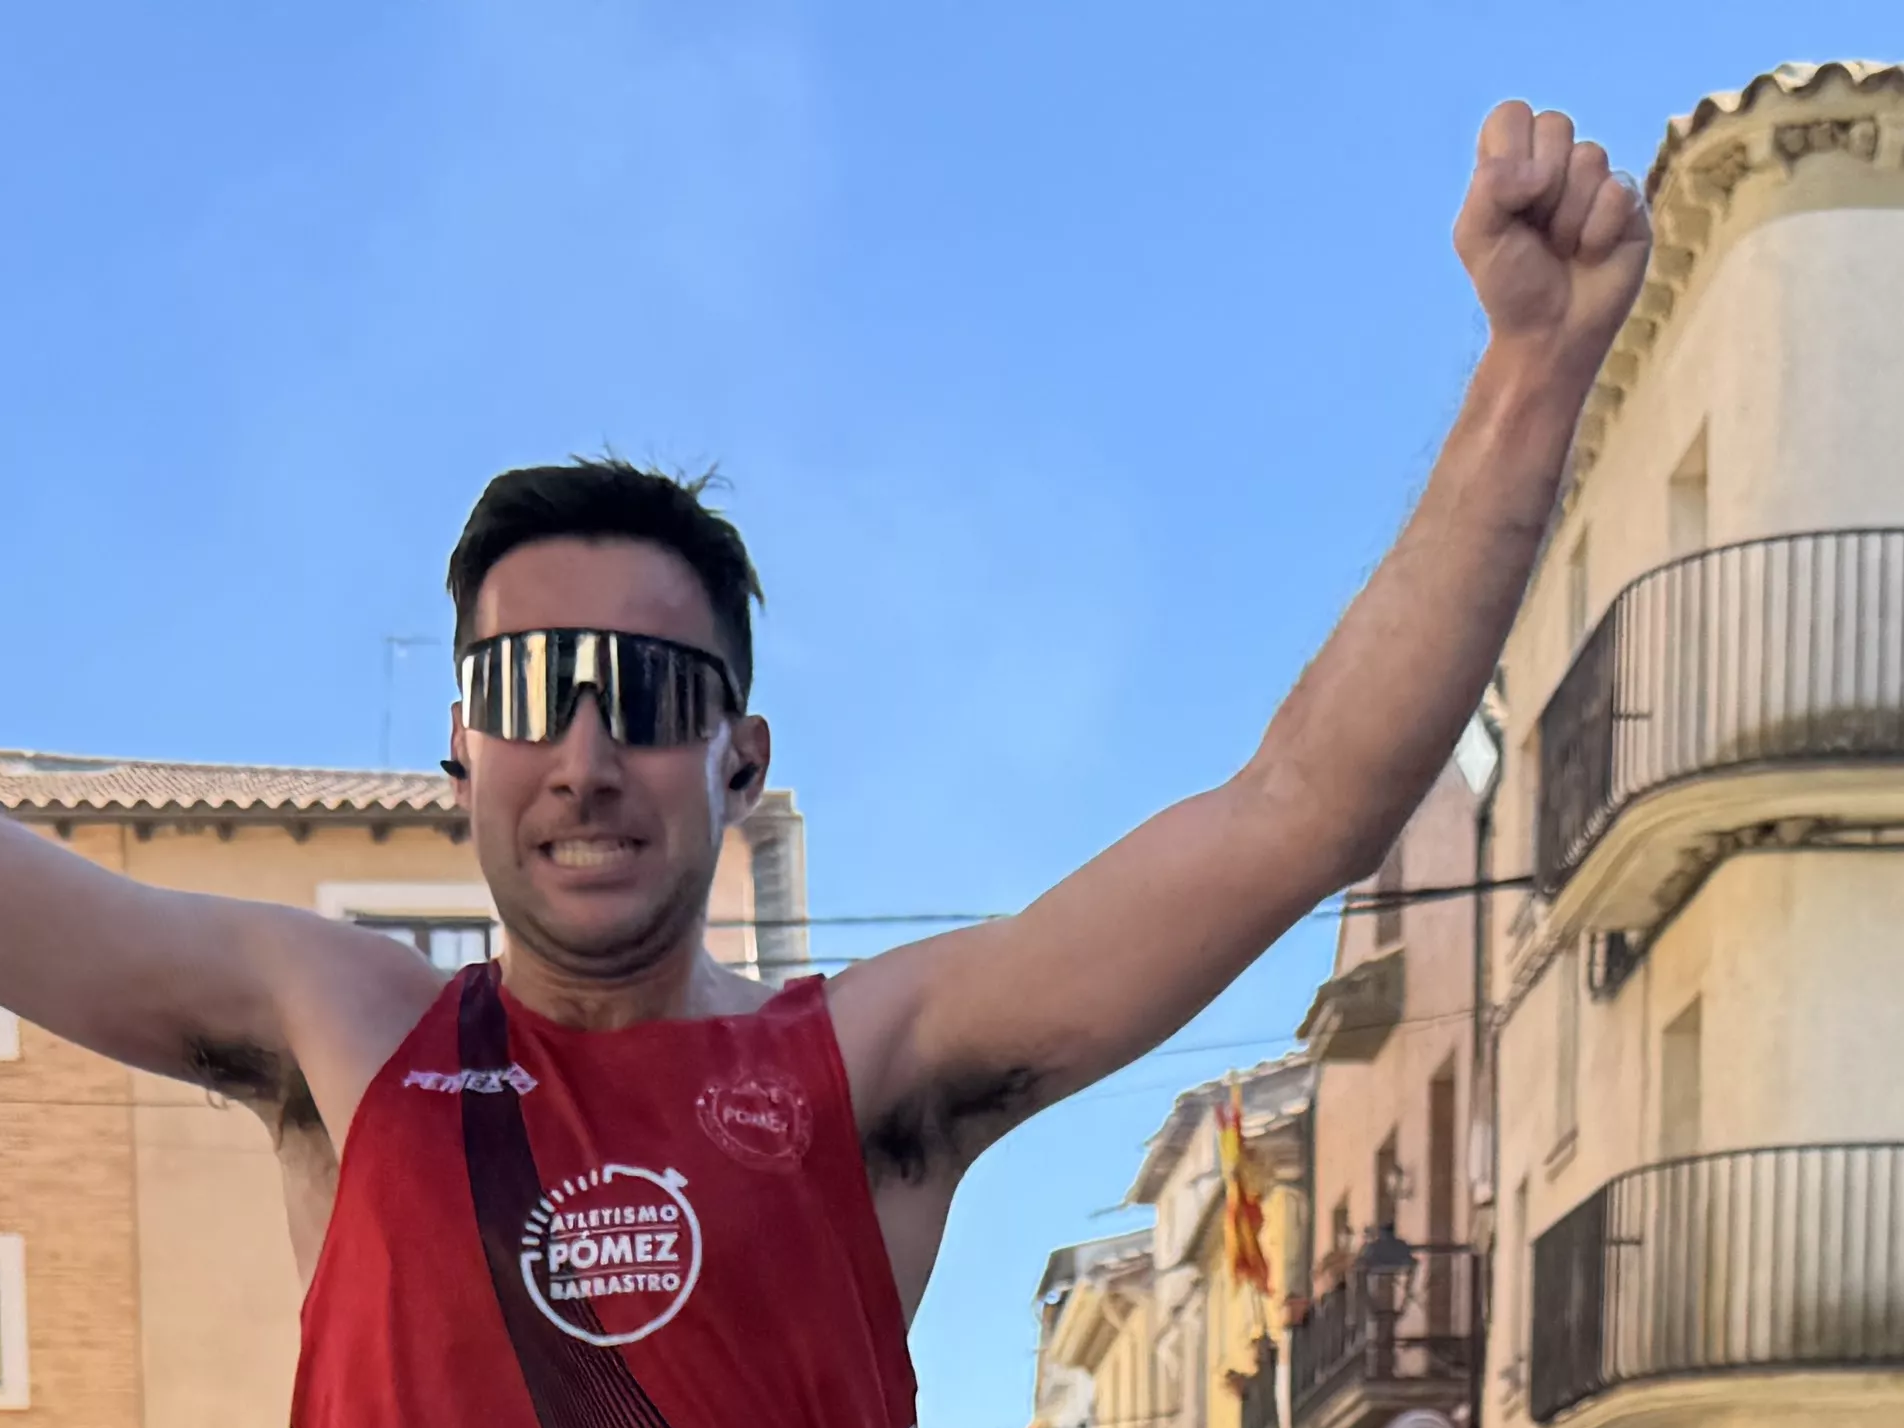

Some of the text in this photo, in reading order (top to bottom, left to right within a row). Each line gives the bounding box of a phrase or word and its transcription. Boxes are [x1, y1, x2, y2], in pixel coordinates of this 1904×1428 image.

[550, 1204, 679, 1234] ATLETISMO
[549, 1230, 679, 1273] PÓMEZ
[550, 1272, 681, 1300] BARBASTRO
